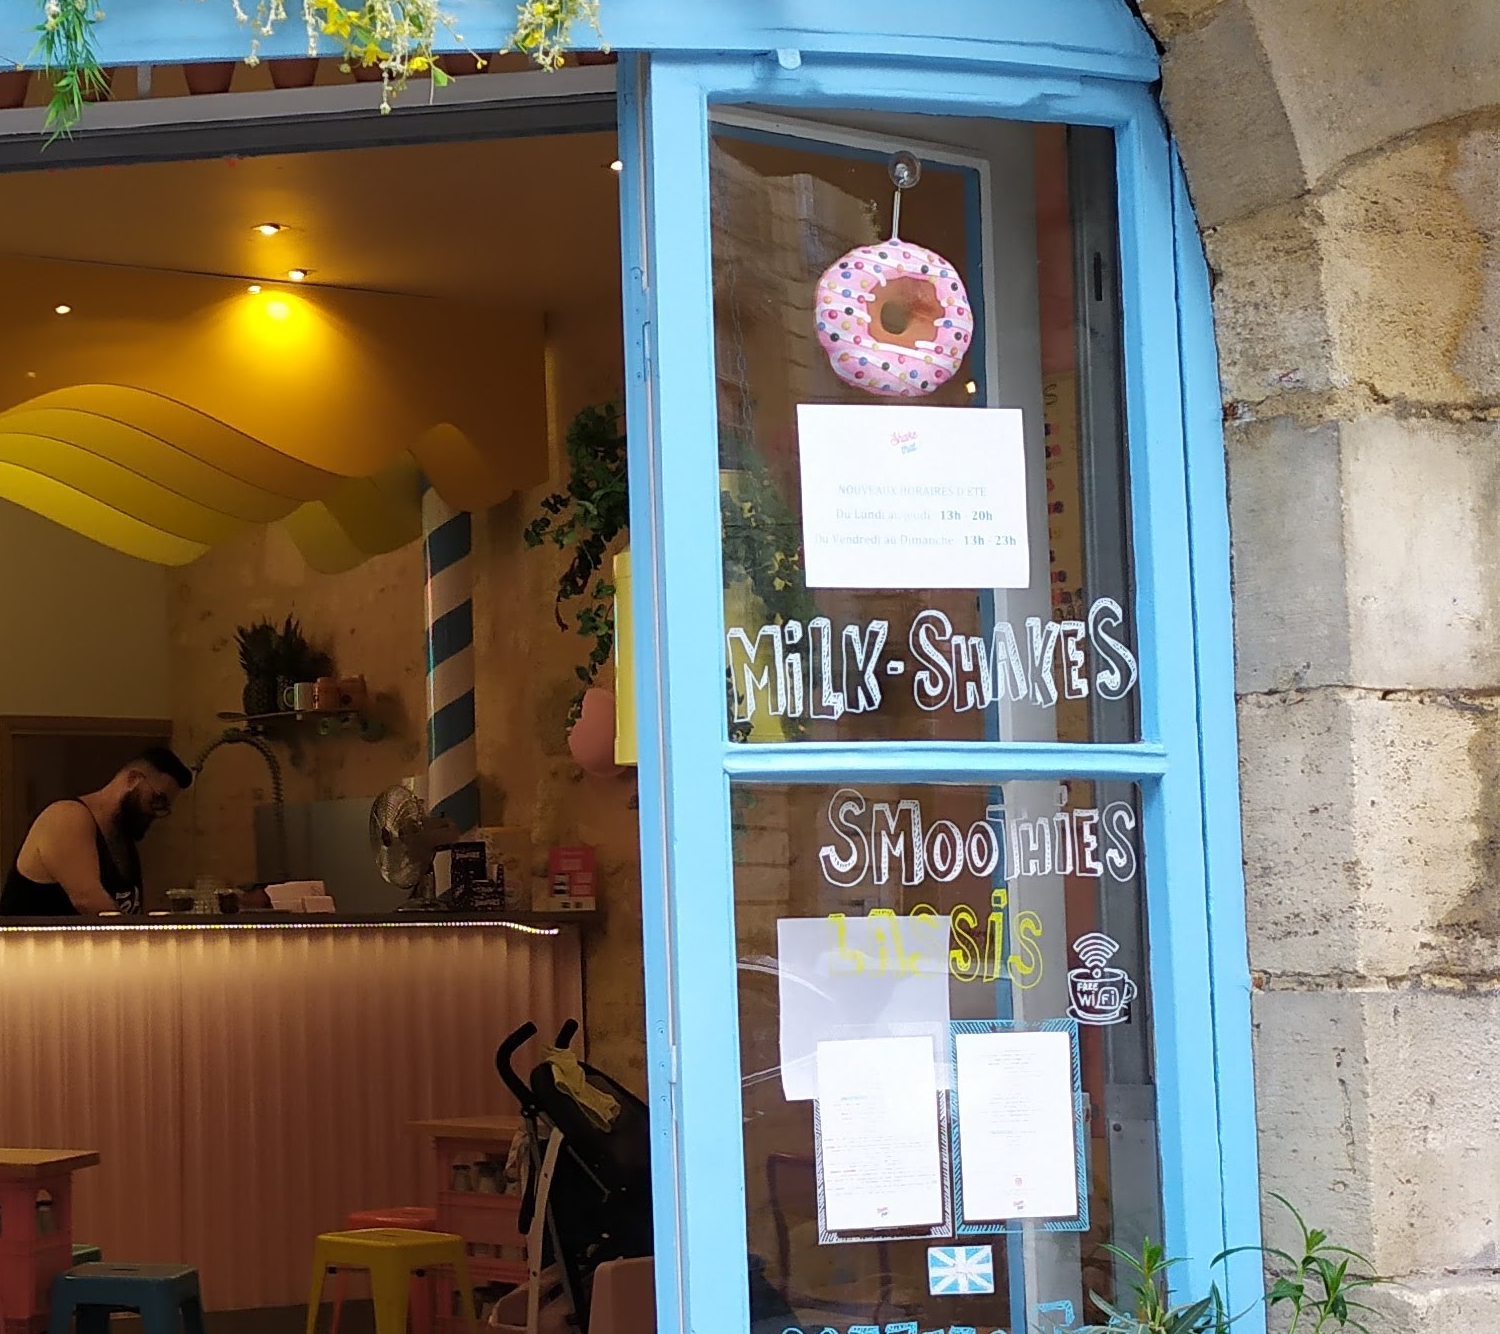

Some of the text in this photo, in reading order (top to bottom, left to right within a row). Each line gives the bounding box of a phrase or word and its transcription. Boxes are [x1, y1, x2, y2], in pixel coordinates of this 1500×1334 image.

[838, 484, 896, 496] NOUVEAUX
[900, 485, 954, 497] HORAIRES
[836, 509, 851, 520] Du
[854, 509, 884, 520] Lundi
[940, 510, 961, 521] 13h
[971, 510, 993, 521] 20h
[831, 534, 881, 546] Vendredi
[900, 534, 954, 546] Dimanche
[964, 535, 985, 546] 13h
[995, 535, 1017, 546] 23h
